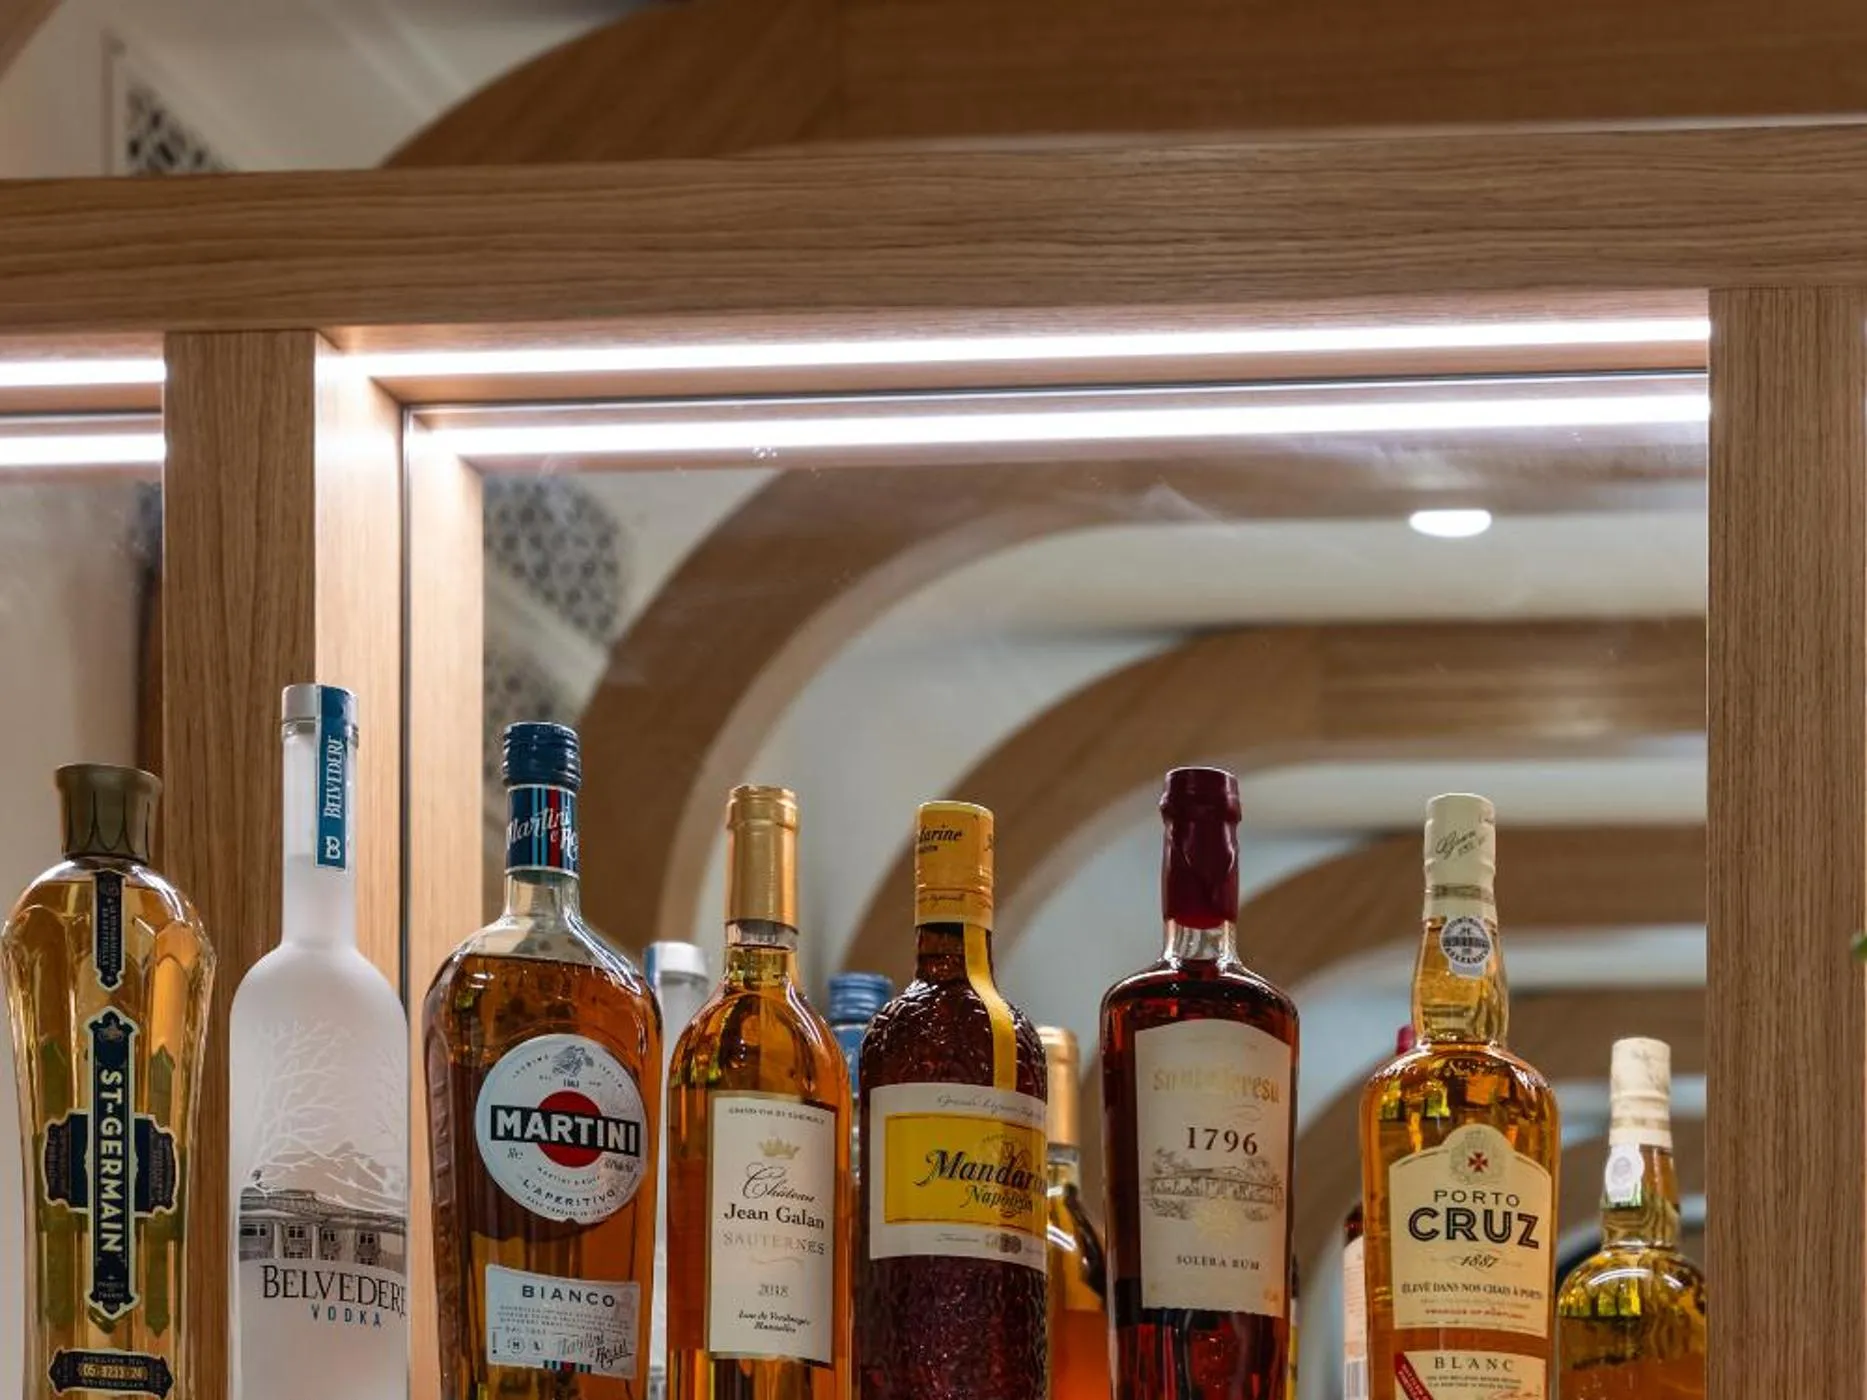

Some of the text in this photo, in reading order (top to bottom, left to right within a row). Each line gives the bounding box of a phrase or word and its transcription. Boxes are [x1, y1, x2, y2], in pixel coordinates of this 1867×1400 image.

[495, 1108, 637, 1153] MARTINI
[1186, 1126, 1258, 1156] 1796
[1433, 1189, 1521, 1208] PORTO
[723, 1203, 826, 1231] Jean Galan
[1408, 1206, 1540, 1250] CRUZ
[723, 1231, 826, 1256] SAUTERNES
[521, 1285, 616, 1308] BIANCO
[311, 1304, 382, 1328] VODKA
[1434, 1356, 1514, 1372] BLANC
